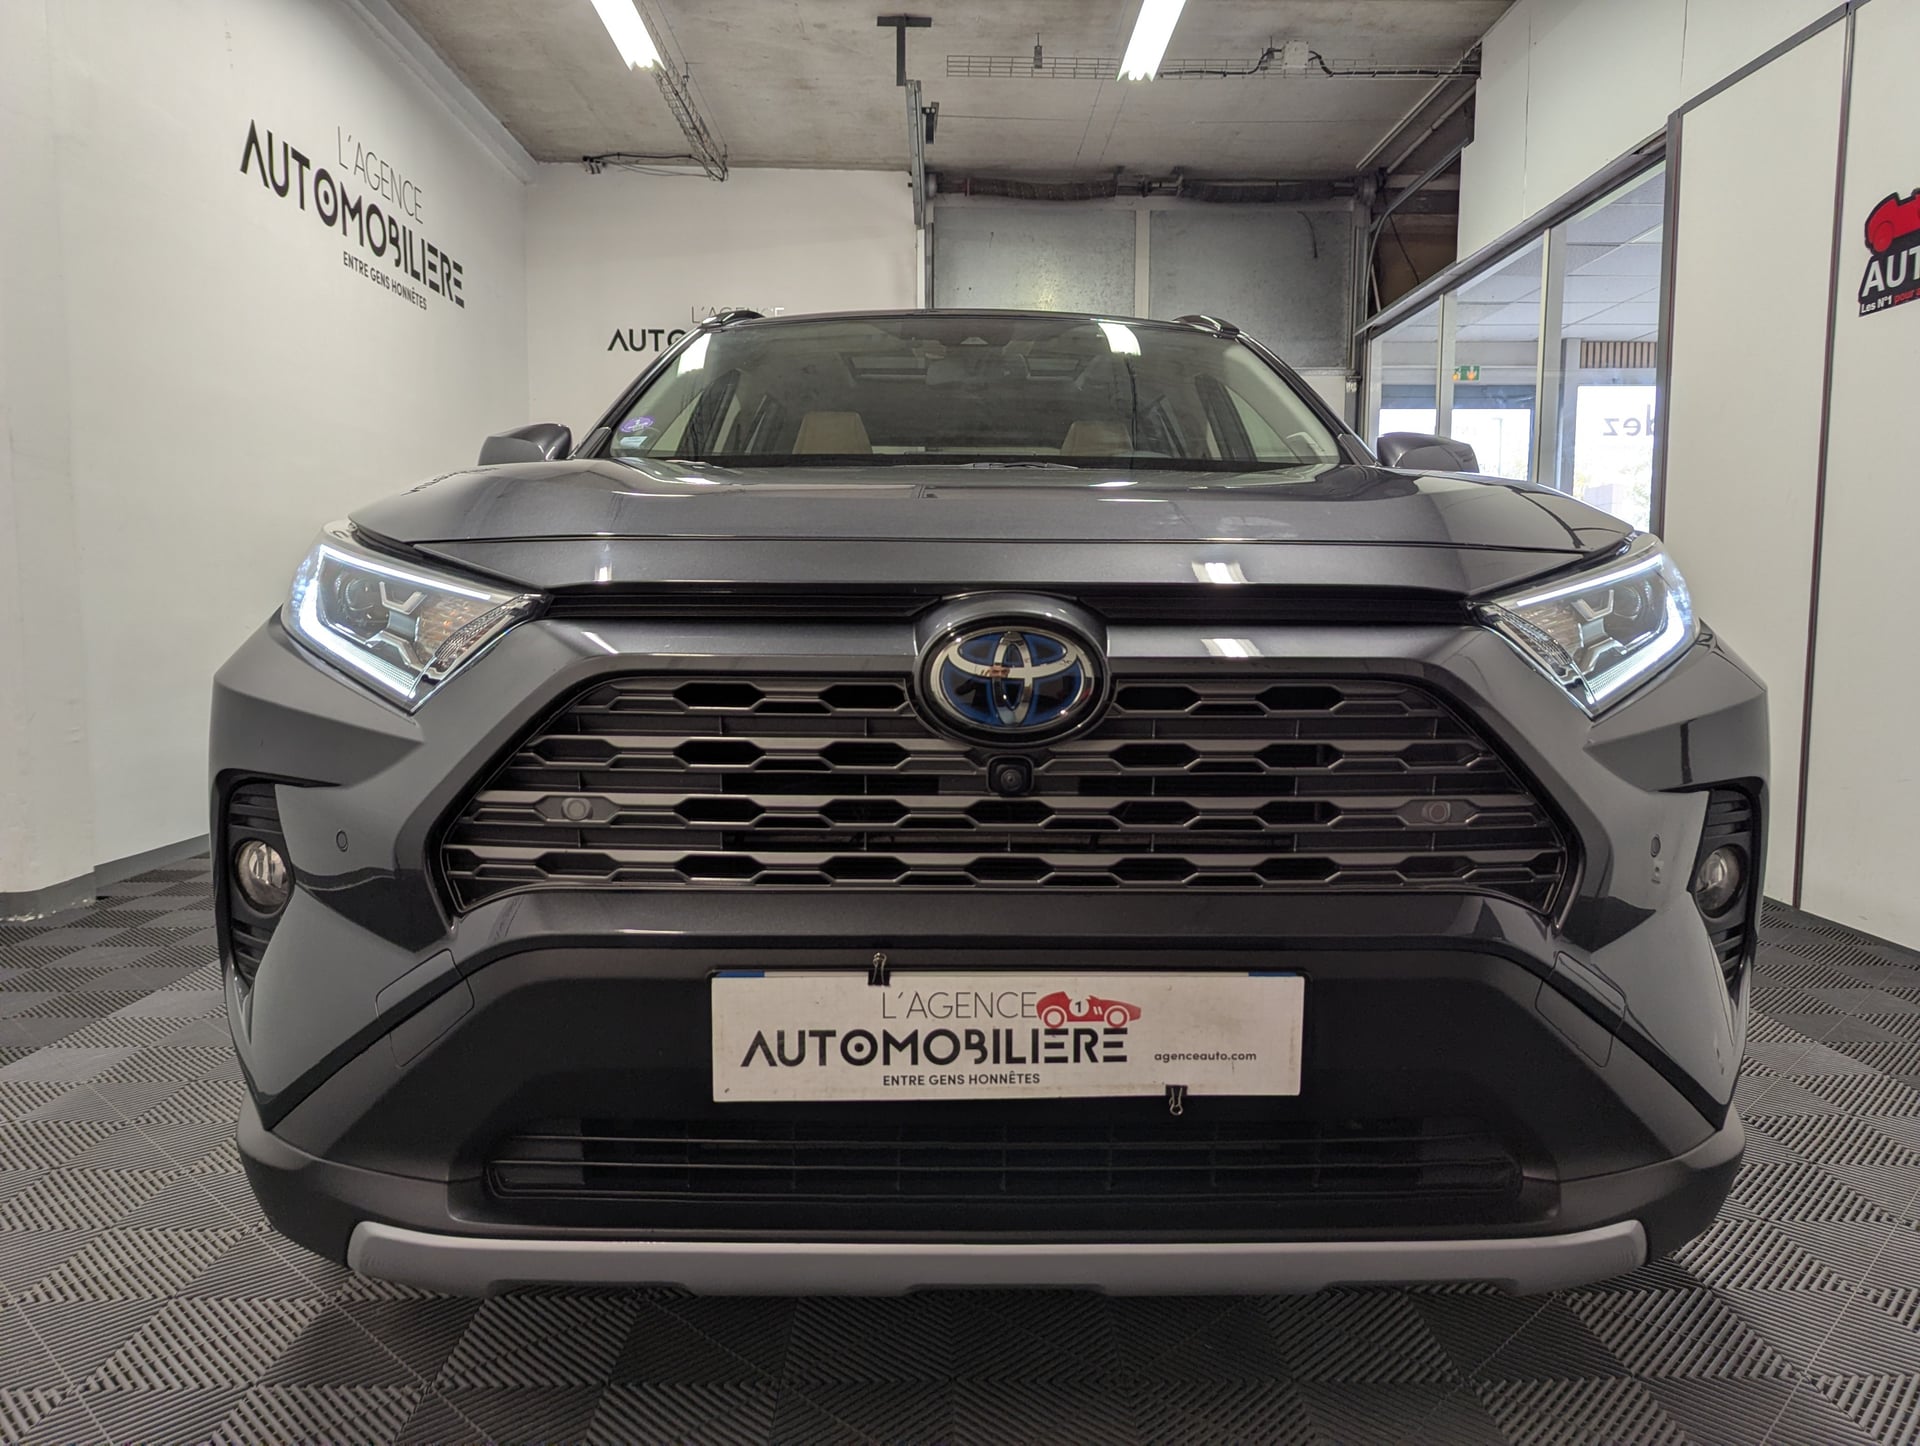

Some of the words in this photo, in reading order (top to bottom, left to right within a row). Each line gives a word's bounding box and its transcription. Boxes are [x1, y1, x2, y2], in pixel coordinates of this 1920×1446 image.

[337, 125, 424, 225] L'AGENCE
[239, 118, 465, 309] AUTOMOBILIERE
[343, 251, 369, 278] ENTRE
[369, 267, 391, 291] GENS
[881, 991, 1038, 1020] L'AGENCE
[740, 1027, 1128, 1067] AUTOMOBILIERE
[1154, 1050, 1257, 1063] agenceauto.com
[882, 1074, 926, 1086] ENTRE
[928, 1073, 965, 1086] GENS
[968, 1069, 1041, 1085] HONNÊTES
